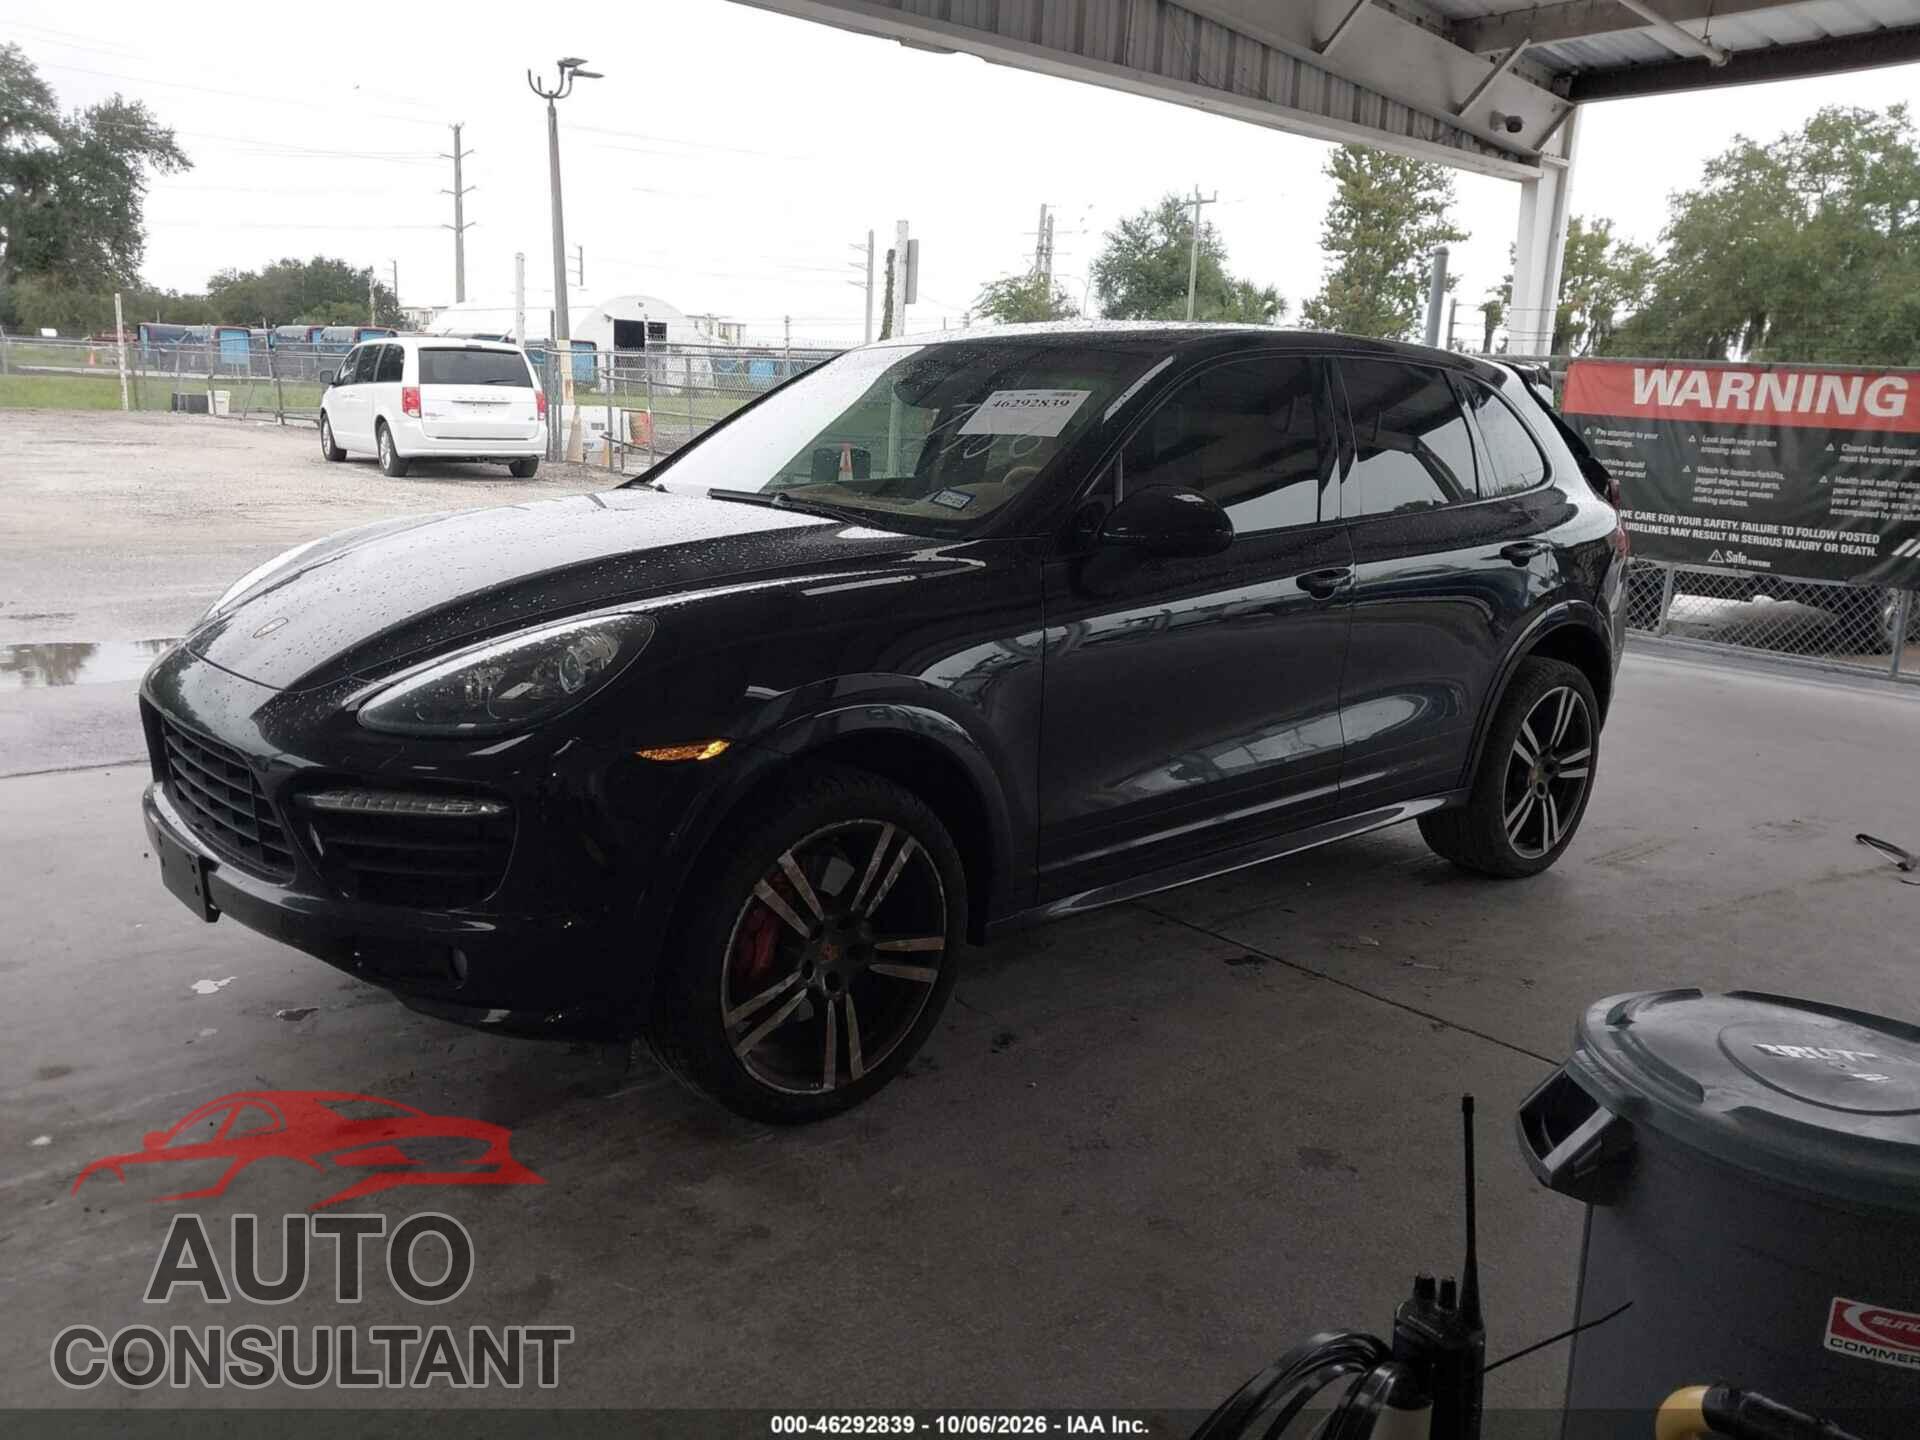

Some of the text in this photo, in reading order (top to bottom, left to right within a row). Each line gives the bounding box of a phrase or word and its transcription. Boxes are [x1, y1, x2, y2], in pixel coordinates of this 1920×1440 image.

[1633, 367, 1909, 417] WARNING
[1619, 509, 1880, 544] WE CARE FOR YOUR SAFETY. FAILURE TO FOLLOW POSTED
[1624, 521, 1878, 557] UIDELINES MAY RESULT IN SERIOUS INJURY OR DEATH.
